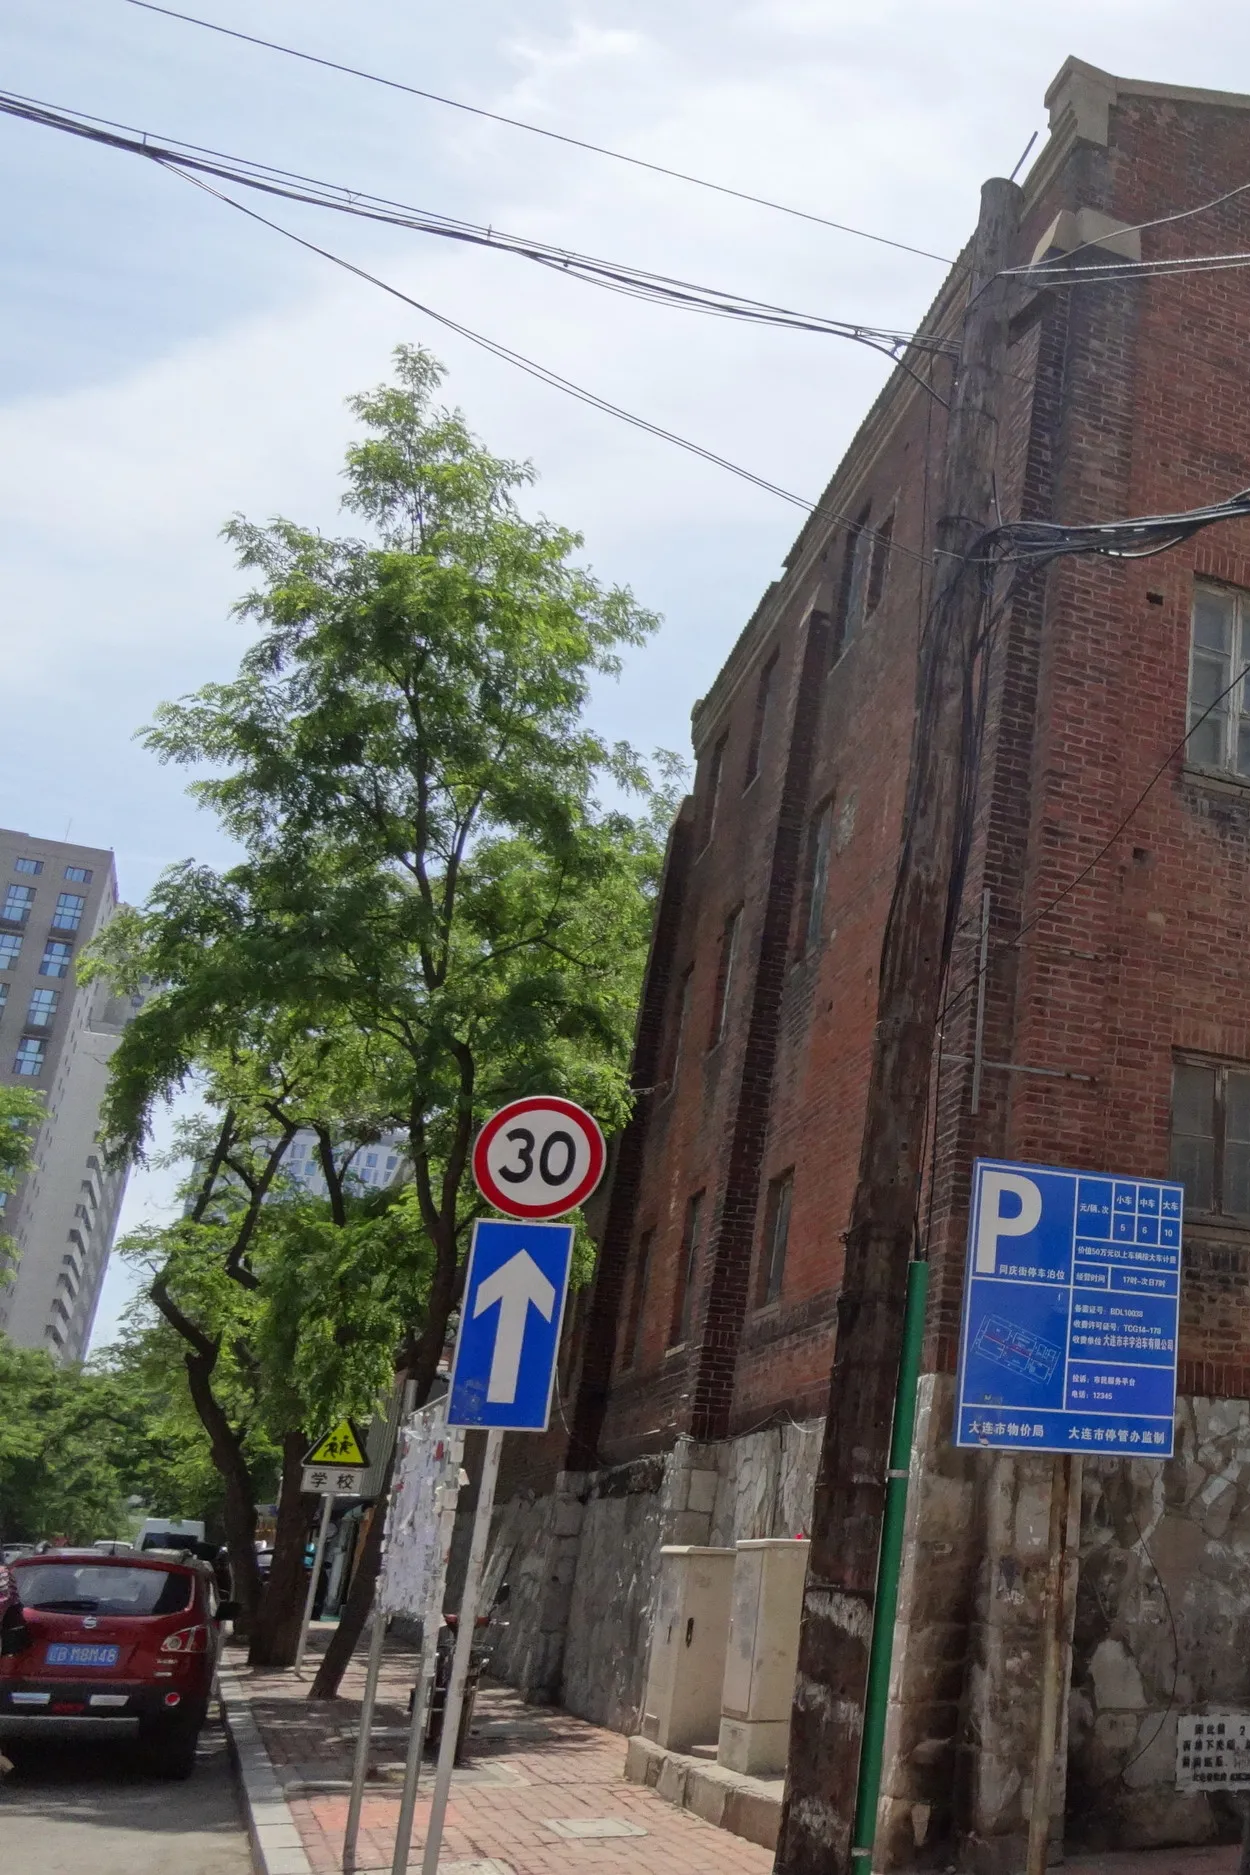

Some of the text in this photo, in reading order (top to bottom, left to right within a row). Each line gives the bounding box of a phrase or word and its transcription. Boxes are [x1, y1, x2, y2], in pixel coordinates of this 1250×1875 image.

[498, 1127, 576, 1186] 30
[1116, 1196, 1133, 1205] 小车
[1140, 1199, 1156, 1208] 中车
[1162, 1201, 1179, 1211] 大车
[976, 1170, 1042, 1274] P
[1120, 1223, 1126, 1232] 5
[1142, 1226, 1148, 1234] 6
[1164, 1229, 1173, 1237] 10
[968, 1420, 1165, 1445] 大连市物价局 大连市停管办监制
[311, 1472, 355, 1490] 学校
